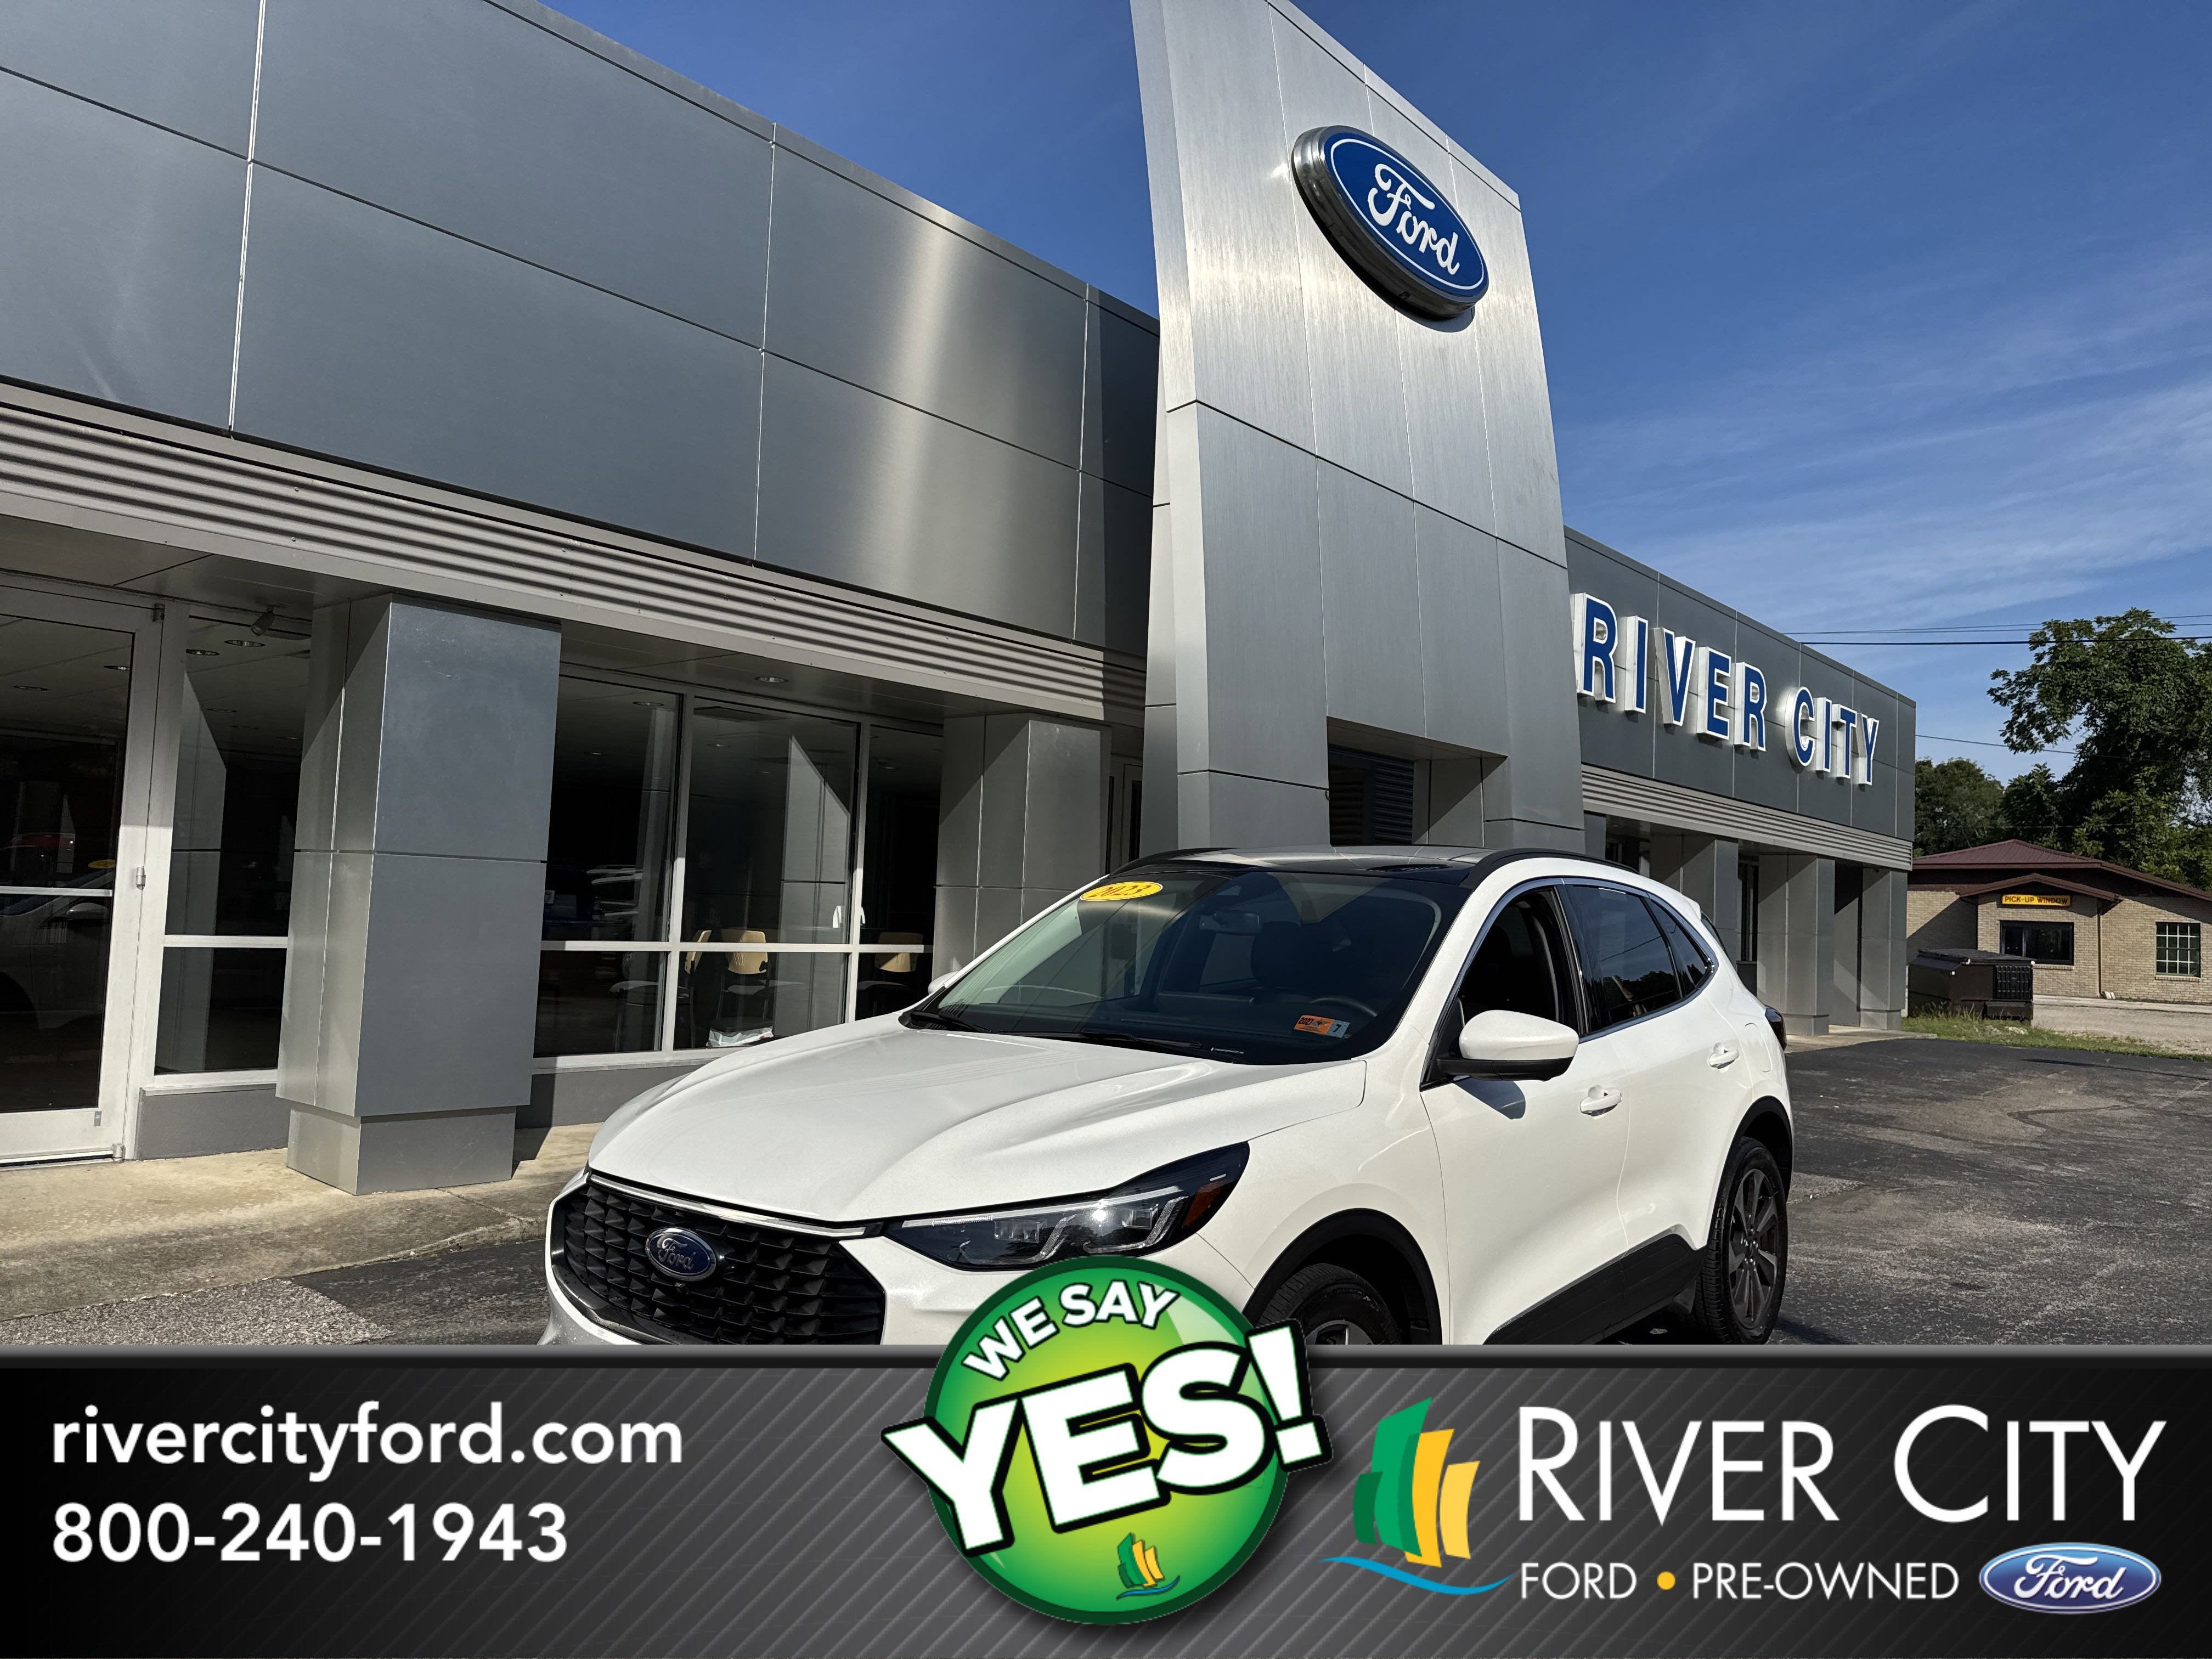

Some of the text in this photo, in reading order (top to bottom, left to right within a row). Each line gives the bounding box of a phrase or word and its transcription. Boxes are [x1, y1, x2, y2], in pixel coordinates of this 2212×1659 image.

[1368, 163, 1460, 275] Ford
[1576, 593, 1879, 785] RIVER CITY
[1298, 1017, 1314, 1025] 2027
[658, 1238, 697, 1270] Ford
